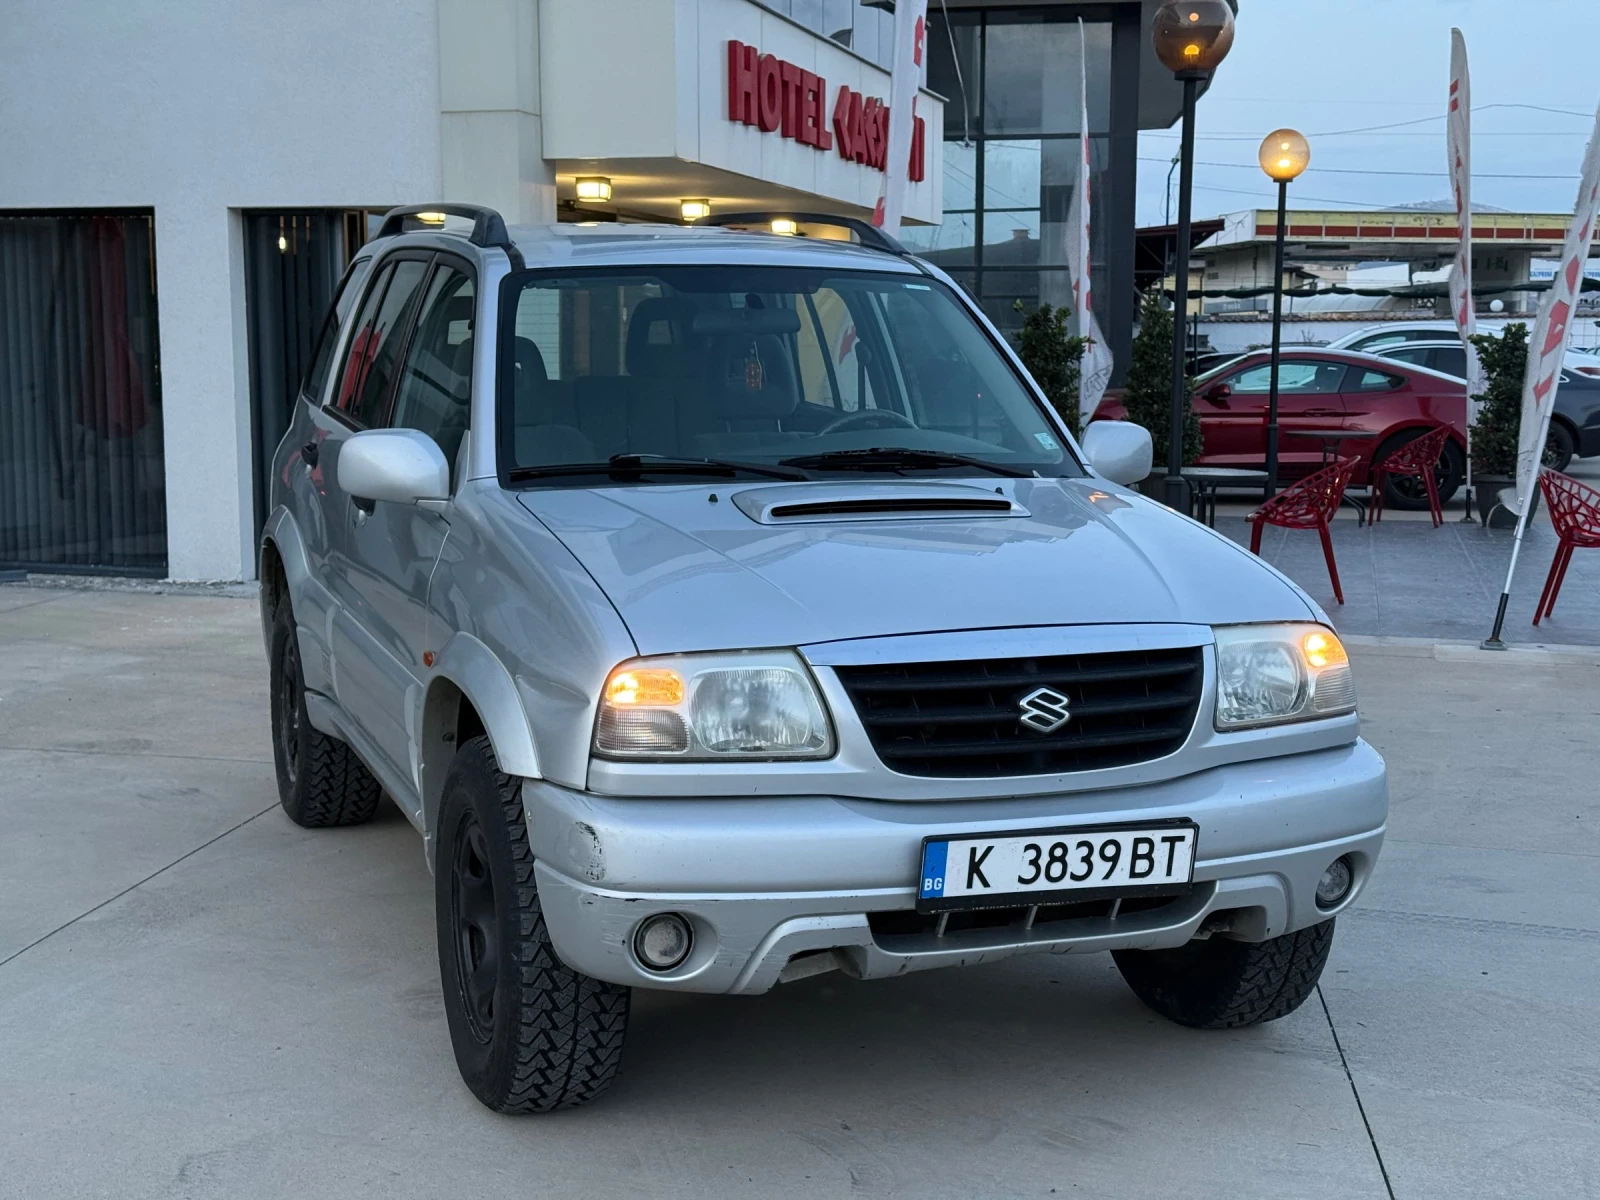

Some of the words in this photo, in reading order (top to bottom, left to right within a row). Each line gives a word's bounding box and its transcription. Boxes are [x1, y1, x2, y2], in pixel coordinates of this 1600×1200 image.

[728, 40, 832, 150] HOTEL
[923, 877, 942, 891] BG
[966, 845, 995, 889] K
